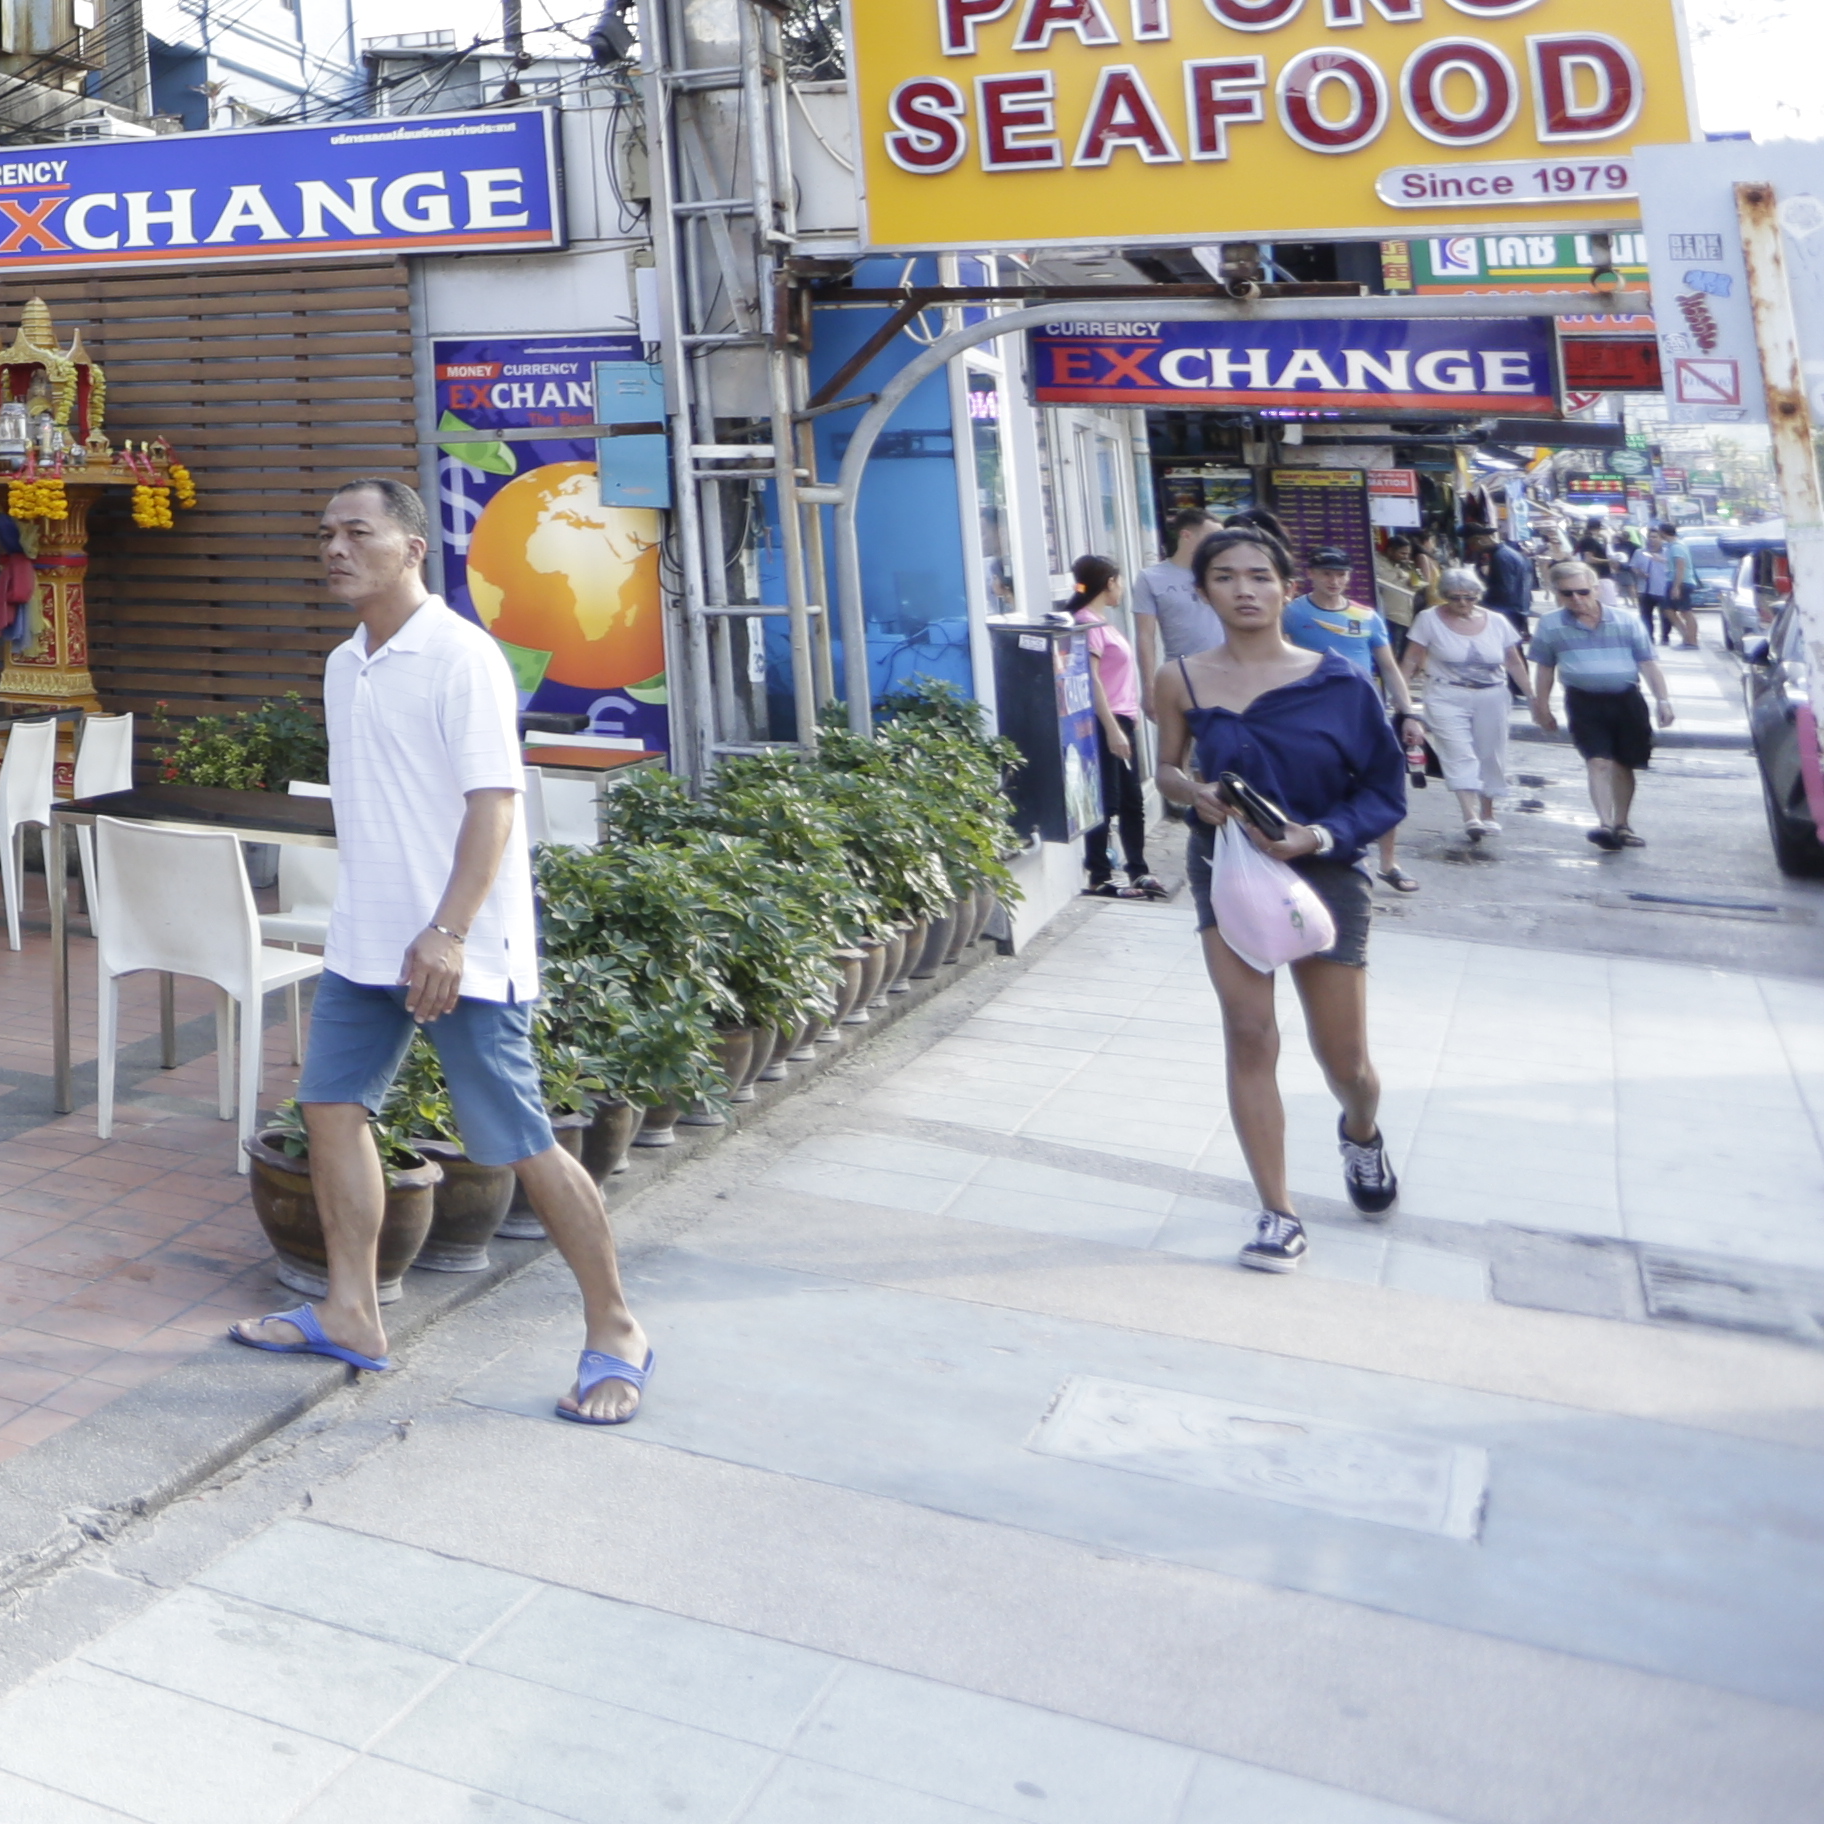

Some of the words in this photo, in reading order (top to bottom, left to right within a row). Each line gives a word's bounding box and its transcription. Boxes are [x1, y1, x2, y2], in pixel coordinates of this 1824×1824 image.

[884, 30, 1644, 174] SEAFOOD
[1402, 173, 1514, 198] Since
[1533, 164, 1629, 193] 1979
[1045, 321, 1162, 336] CURRENCY
[447, 366, 493, 377] MONEY
[503, 363, 578, 376] CURRENCY
[1051, 348, 1536, 393] EXCHANGE
[449, 381, 592, 409] EXCHAN
